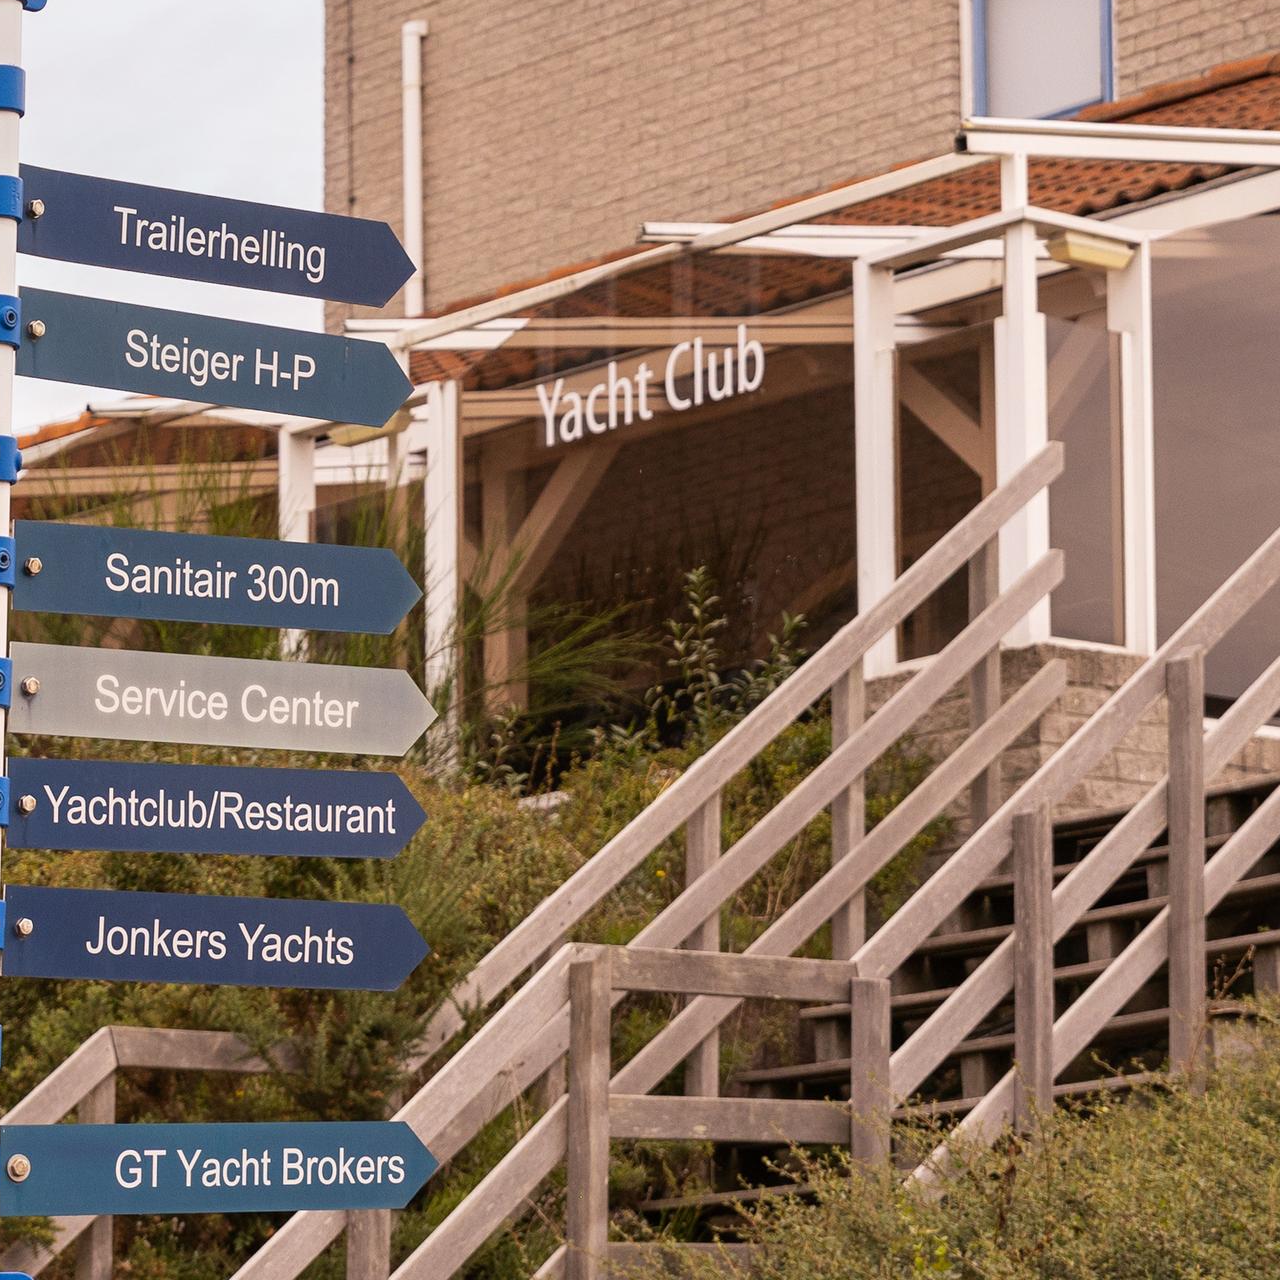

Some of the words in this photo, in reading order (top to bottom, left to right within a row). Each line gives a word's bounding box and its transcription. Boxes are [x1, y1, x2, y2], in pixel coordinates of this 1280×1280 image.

[113, 205, 326, 285] Trailerhelling
[124, 328, 245, 388] Steiger
[254, 347, 316, 391] H-P
[536, 361, 655, 448] Yacht
[664, 323, 765, 412] Club
[105, 552, 238, 600] Sanitair
[246, 563, 339, 608] 300m
[94, 673, 230, 721] Service
[240, 683, 361, 730] Center
[43, 784, 397, 835] Yachtclub/Restaurant
[85, 915, 227, 961] Jonkers
[238, 922, 354, 967] Yachts
[115, 1149, 167, 1189] GT
[175, 1148, 272, 1188] Yacht
[282, 1146, 406, 1187] Brokers
